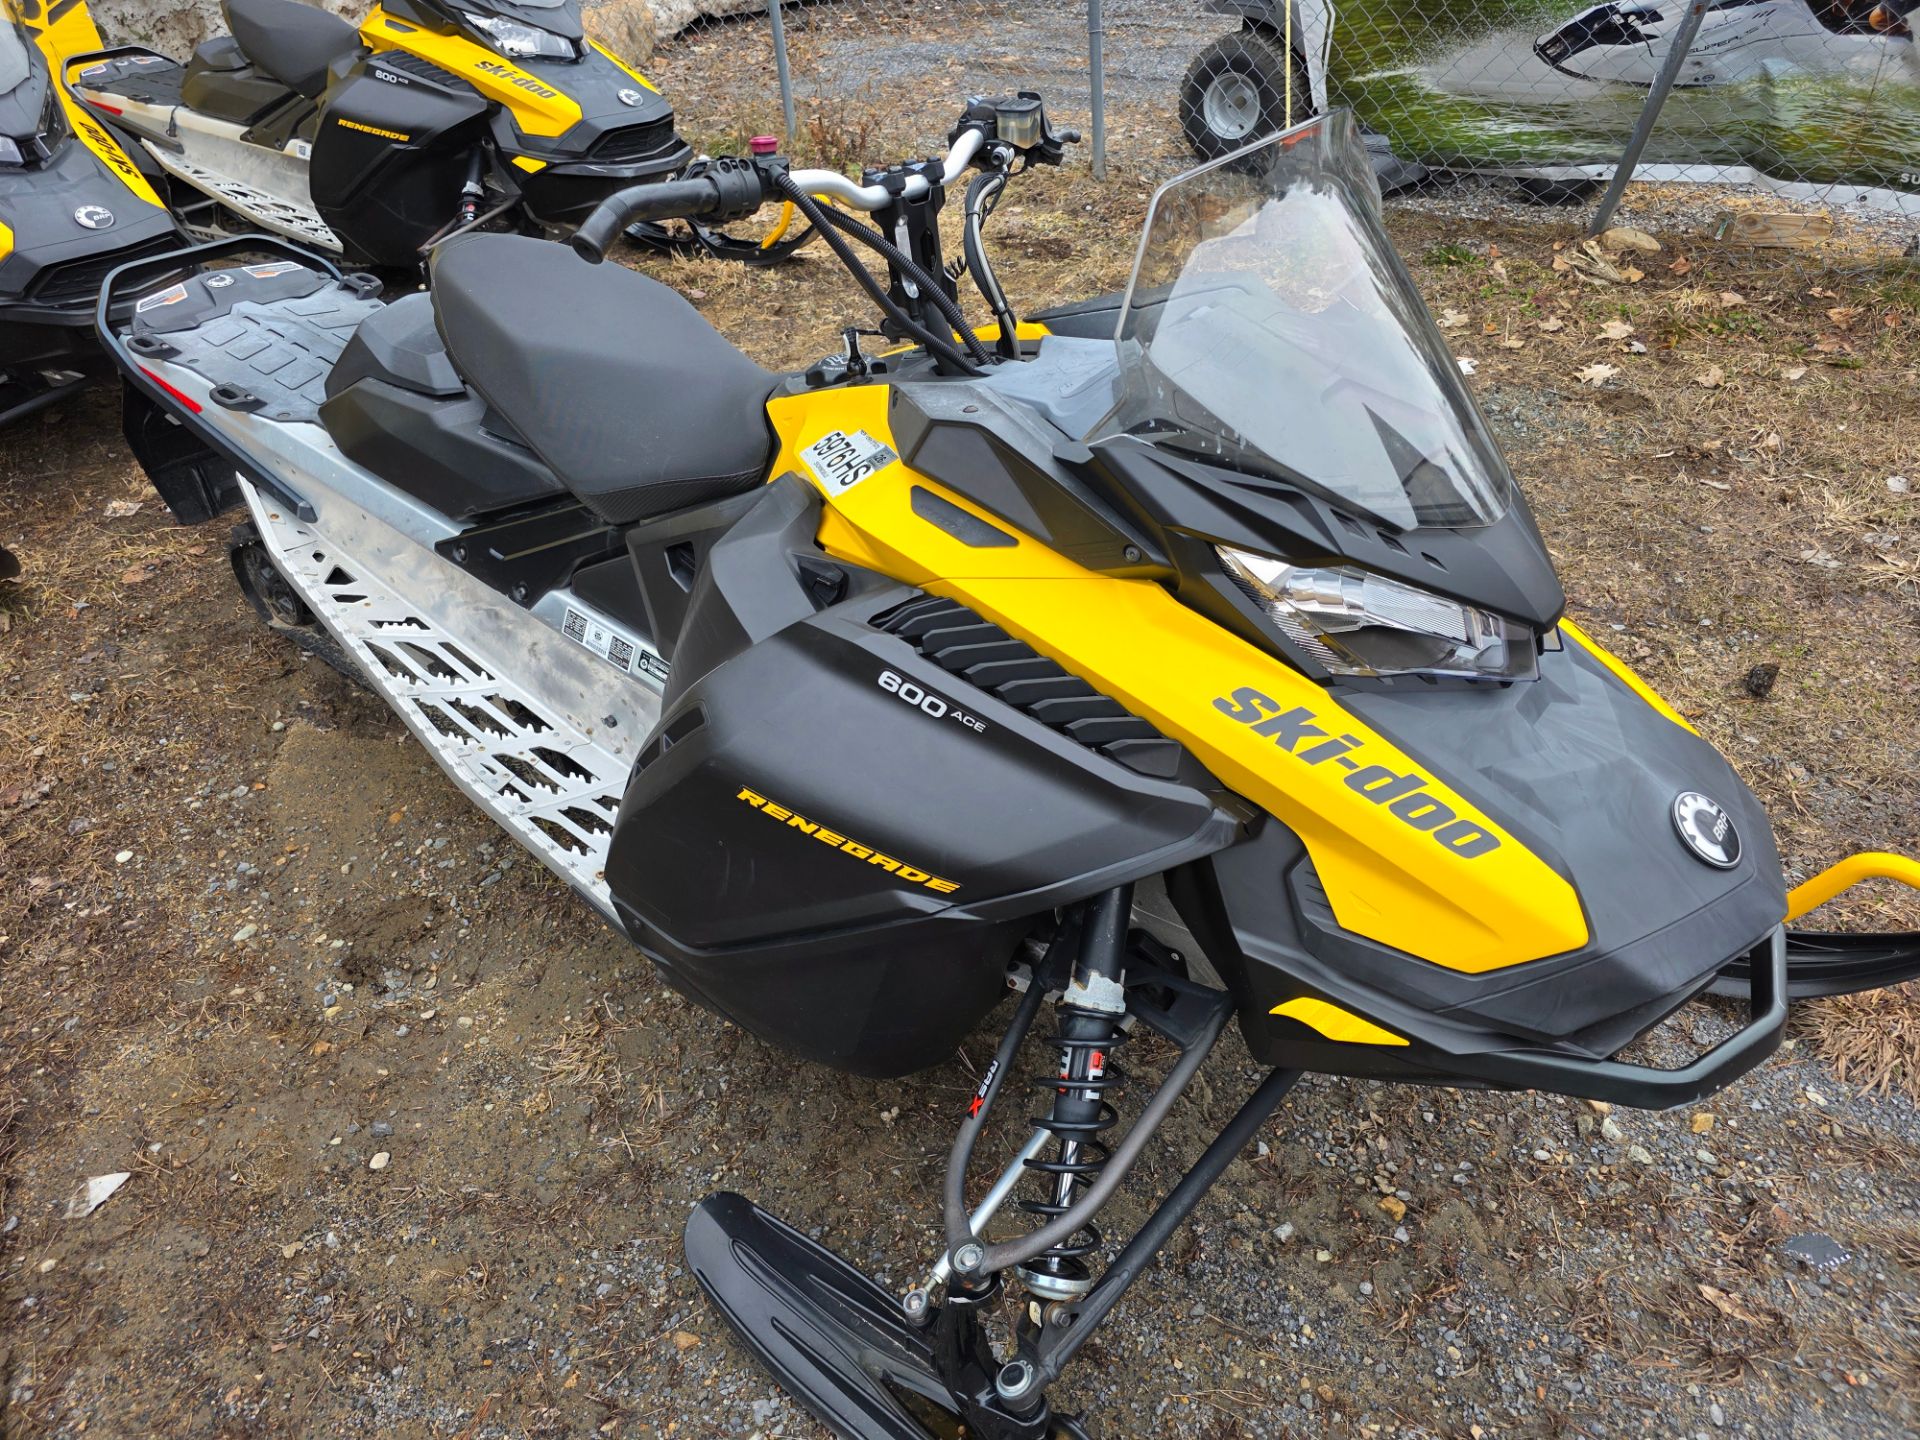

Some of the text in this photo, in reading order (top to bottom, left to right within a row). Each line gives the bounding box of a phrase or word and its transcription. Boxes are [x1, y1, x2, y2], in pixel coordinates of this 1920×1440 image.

[375, 70, 398, 83] 600
[474, 60, 557, 98] ski-doo
[337, 118, 410, 142] RENEGADE
[812, 431, 871, 486] 5976HS
[878, 670, 986, 733] 600 ACE
[1212, 687, 1501, 859] ski-doo
[736, 787, 961, 894] RENEGADE
[1712, 811, 1729, 842] BRP
